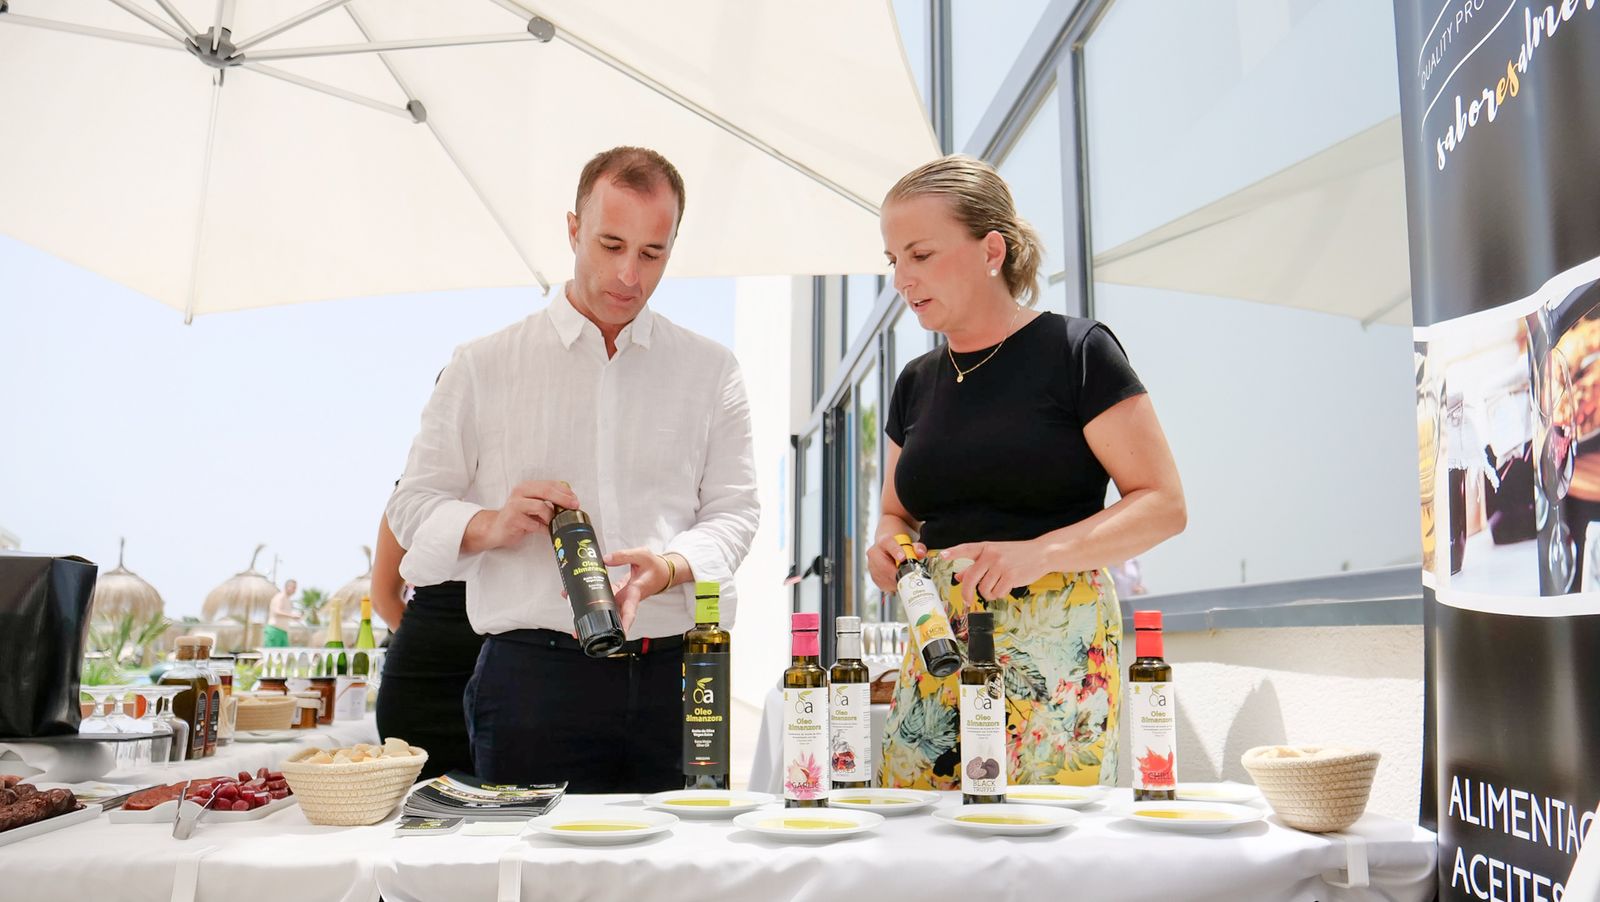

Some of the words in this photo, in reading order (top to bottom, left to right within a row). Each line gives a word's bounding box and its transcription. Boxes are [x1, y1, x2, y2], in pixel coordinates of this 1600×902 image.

[1420, 22, 1453, 91] QUALITY
[694, 707, 712, 716] Oleo
[791, 782, 820, 790] GARLIC
